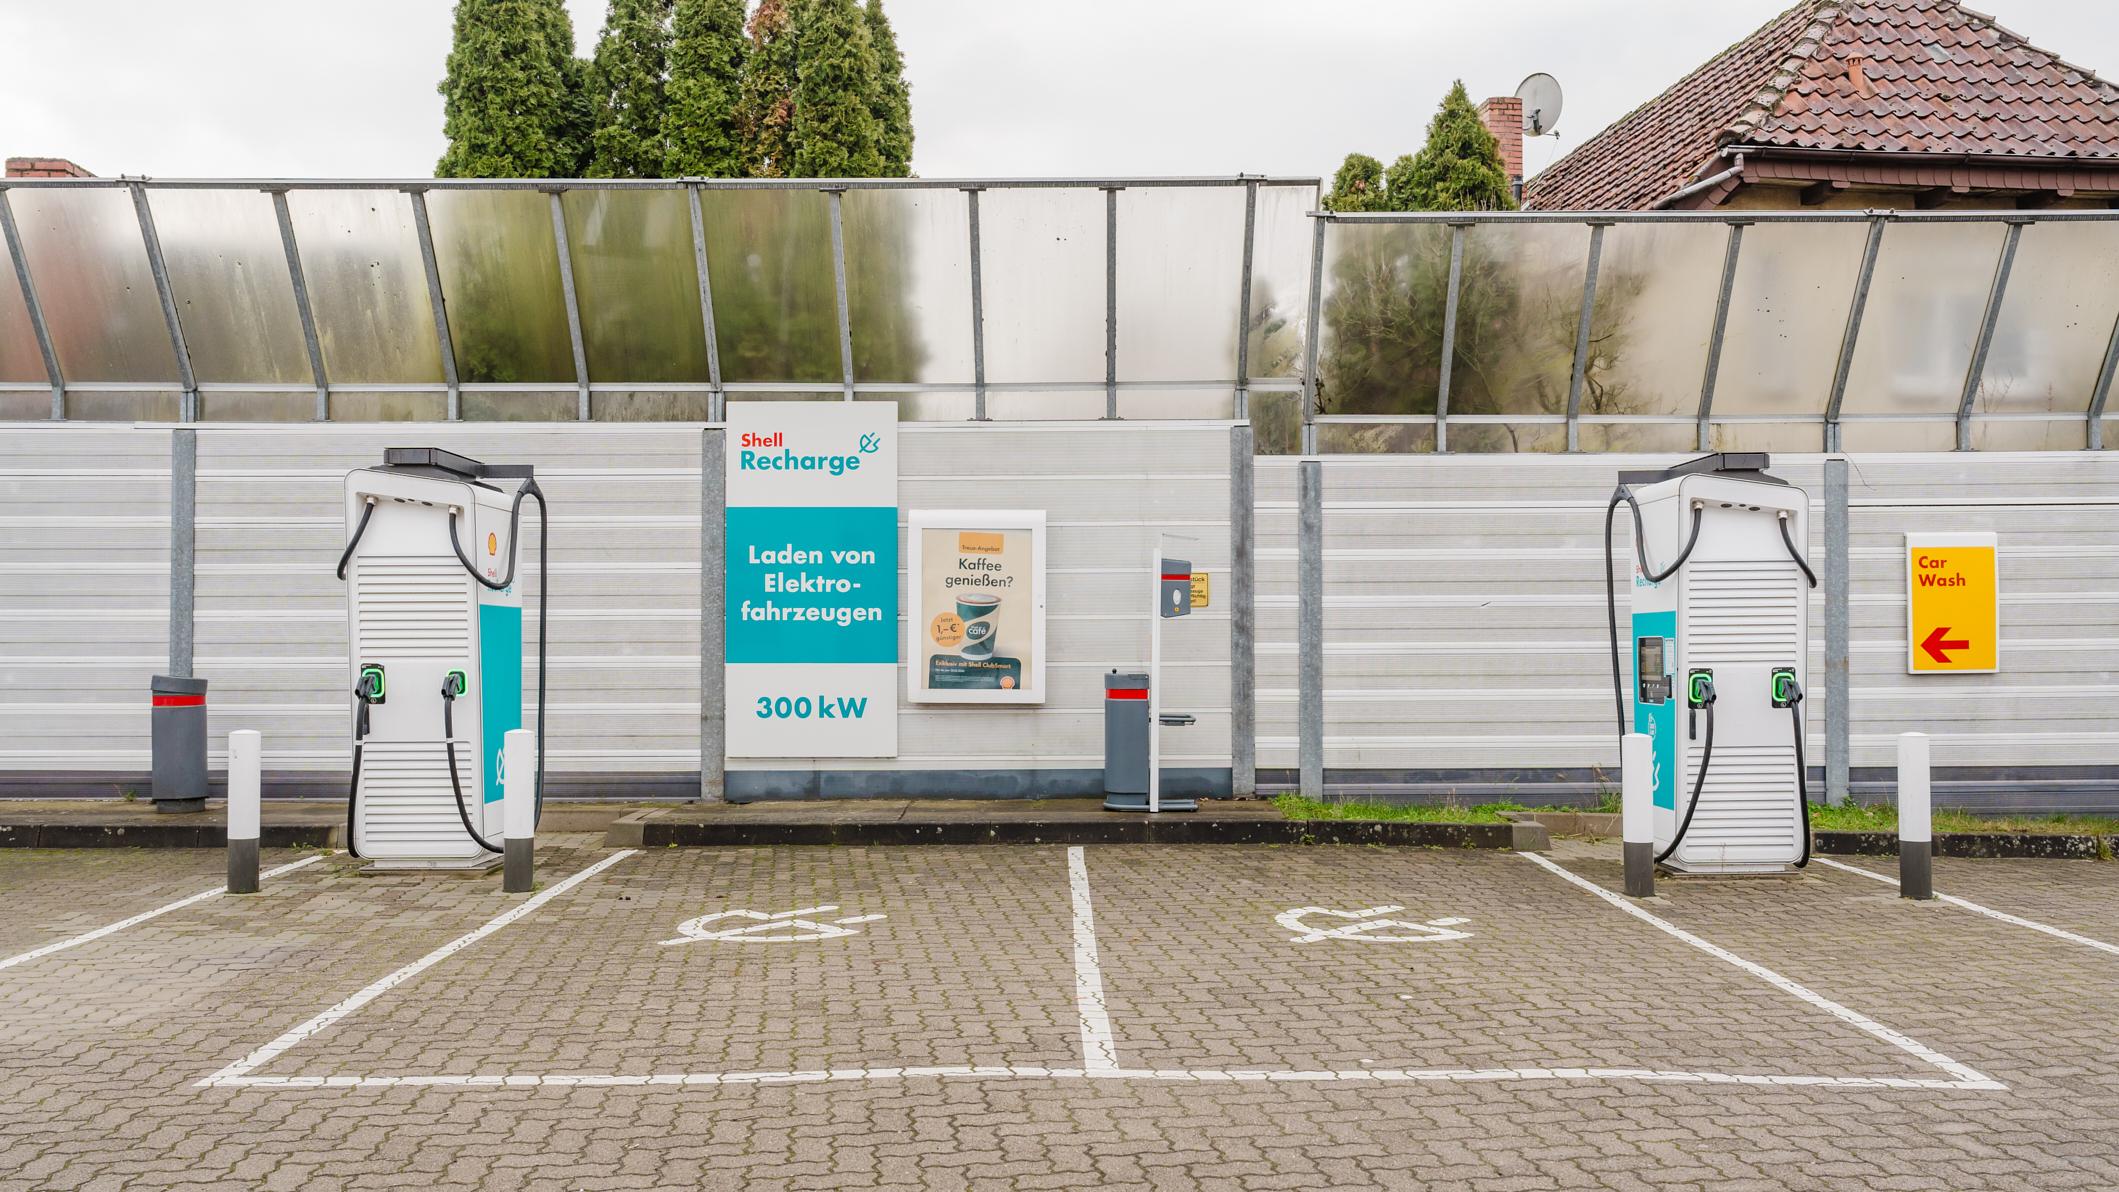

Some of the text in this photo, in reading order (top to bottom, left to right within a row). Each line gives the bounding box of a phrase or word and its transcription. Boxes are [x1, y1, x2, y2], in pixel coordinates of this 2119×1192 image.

[741, 432, 783, 447] Shell
[740, 449, 860, 476] Recharge
[749, 543, 876, 564] Laden von
[1918, 555, 1947, 569] Car
[959, 558, 1002, 571] Kaffee
[764, 572, 861, 593] Elektro-
[945, 573, 1014, 588] genießen?
[1918, 572, 1966, 587] Wash
[740, 600, 882, 627] fahrzeugen
[756, 695, 868, 719] 300 kW
